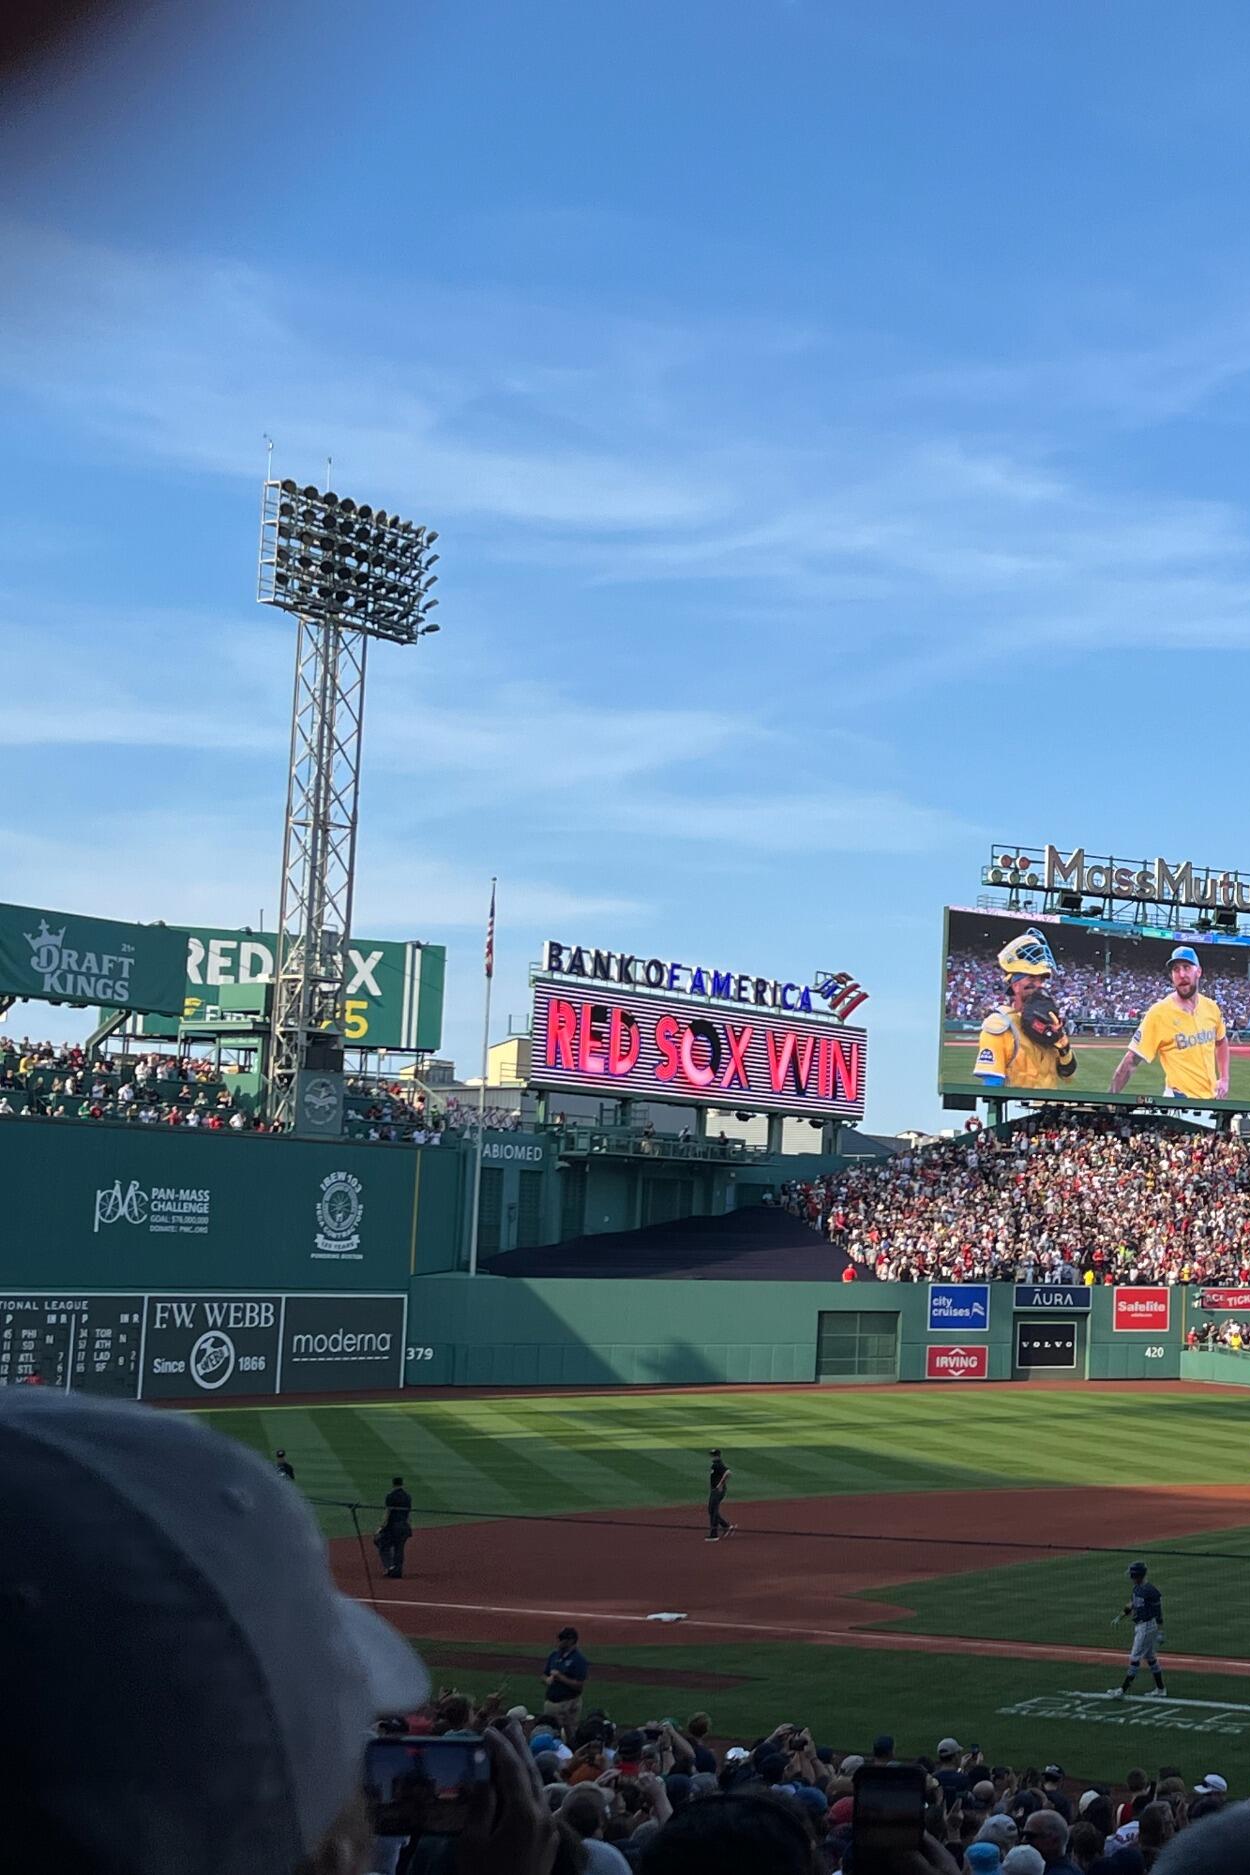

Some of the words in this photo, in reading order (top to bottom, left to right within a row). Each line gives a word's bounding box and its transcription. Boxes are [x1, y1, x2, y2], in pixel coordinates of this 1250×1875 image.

[30, 945, 134, 979] DRAFT
[543, 940, 637, 984] BANK
[644, 957, 683, 990] OF
[690, 967, 813, 1013] AMERICA
[43, 970, 129, 1002] KINGS
[545, 998, 640, 1078] RED
[654, 1014, 753, 1089] SOX
[765, 1029, 858, 1102] WIN
[482, 1143, 543, 1161] ABIOMED
[151, 1187, 210, 1201] PAN-MASS
[150, 1200, 209, 1214] CHALLENGE
[44, 1300, 89, 1310] LEAGUE
[932, 1296, 952, 1307] city
[1118, 1300, 1166, 1313] Safelite
[203, 1302, 275, 1328] WEBB
[932, 1307, 970, 1317] cruises
[95, 1328, 113, 1338] TOR
[292, 1328, 392, 1354] moderna
[18, 1353, 36, 1363] ATL
[58, 1351, 64, 1361] 7
[93, 1351, 111, 1361] LAD
[406, 1347, 434, 1361] 379
[1145, 1347, 1164, 1358] 420
[17, 1364, 34, 1375] STL
[56, 1363, 63, 1373] 6
[153, 1358, 185, 1374] Since
[238, 1356, 266, 1371] 1866
[936, 1356, 978, 1368] IRVING
[55, 1375, 63, 1385] 2
